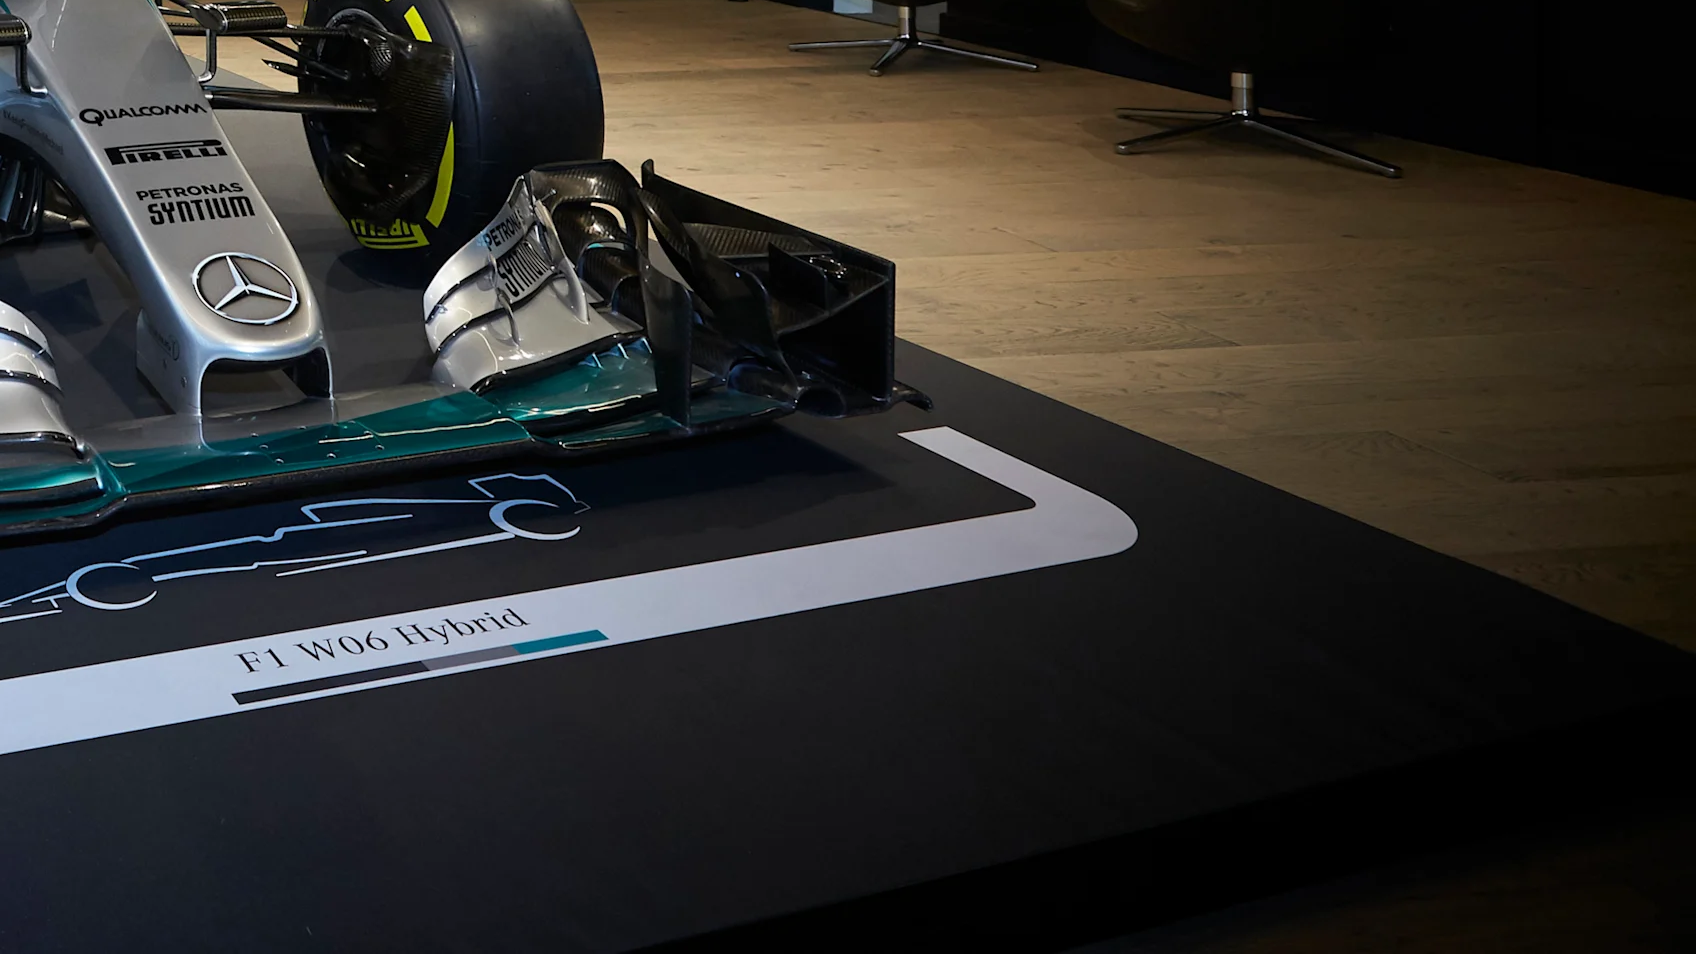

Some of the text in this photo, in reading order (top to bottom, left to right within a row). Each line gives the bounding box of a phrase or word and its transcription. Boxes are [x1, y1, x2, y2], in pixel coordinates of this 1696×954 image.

[79, 103, 208, 127] QUALCOMM
[104, 139, 228, 166] PIRELLI
[136, 182, 244, 201] PETRONAS
[147, 196, 256, 225] SYNTIUM
[234, 608, 531, 674] F1 W06 Hybrid
